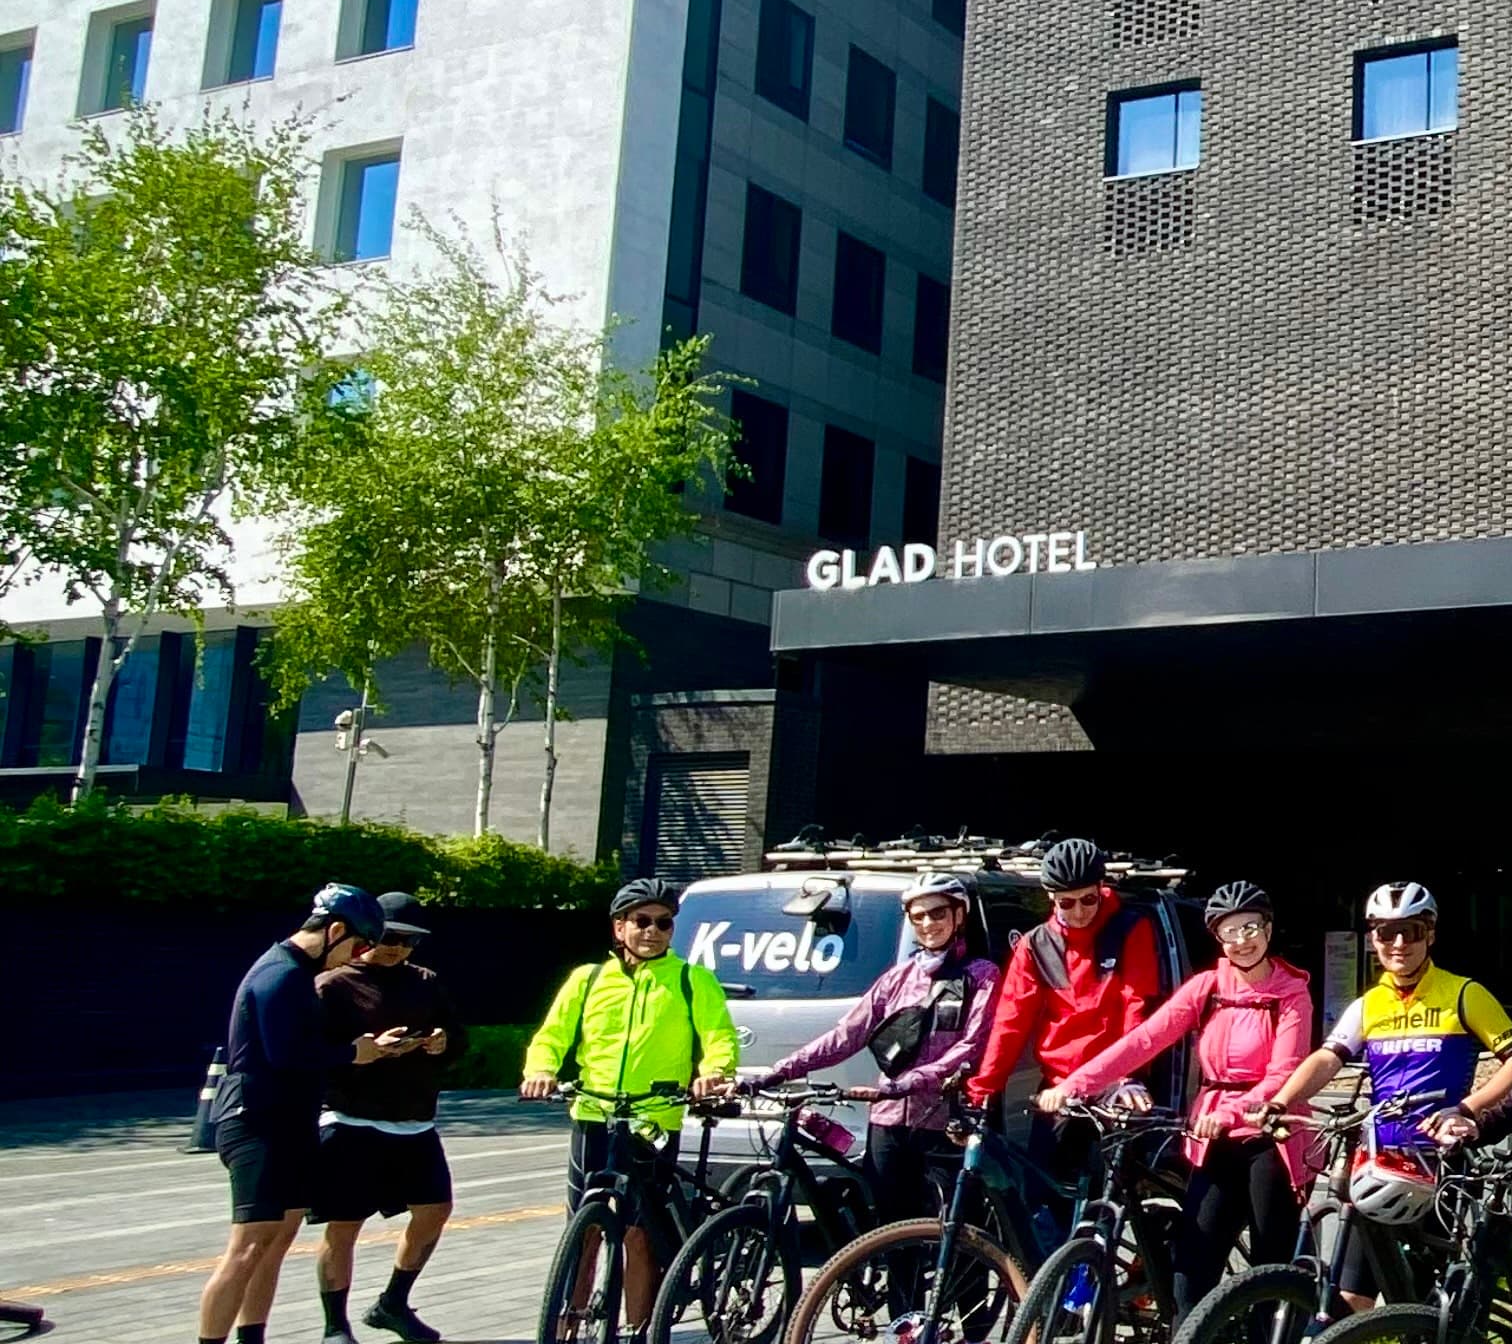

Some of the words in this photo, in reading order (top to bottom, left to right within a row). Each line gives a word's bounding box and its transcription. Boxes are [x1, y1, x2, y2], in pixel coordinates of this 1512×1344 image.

[807, 543, 936, 590] GLAD
[954, 531, 1097, 578] HOTEL
[688, 921, 845, 973] K-velo
